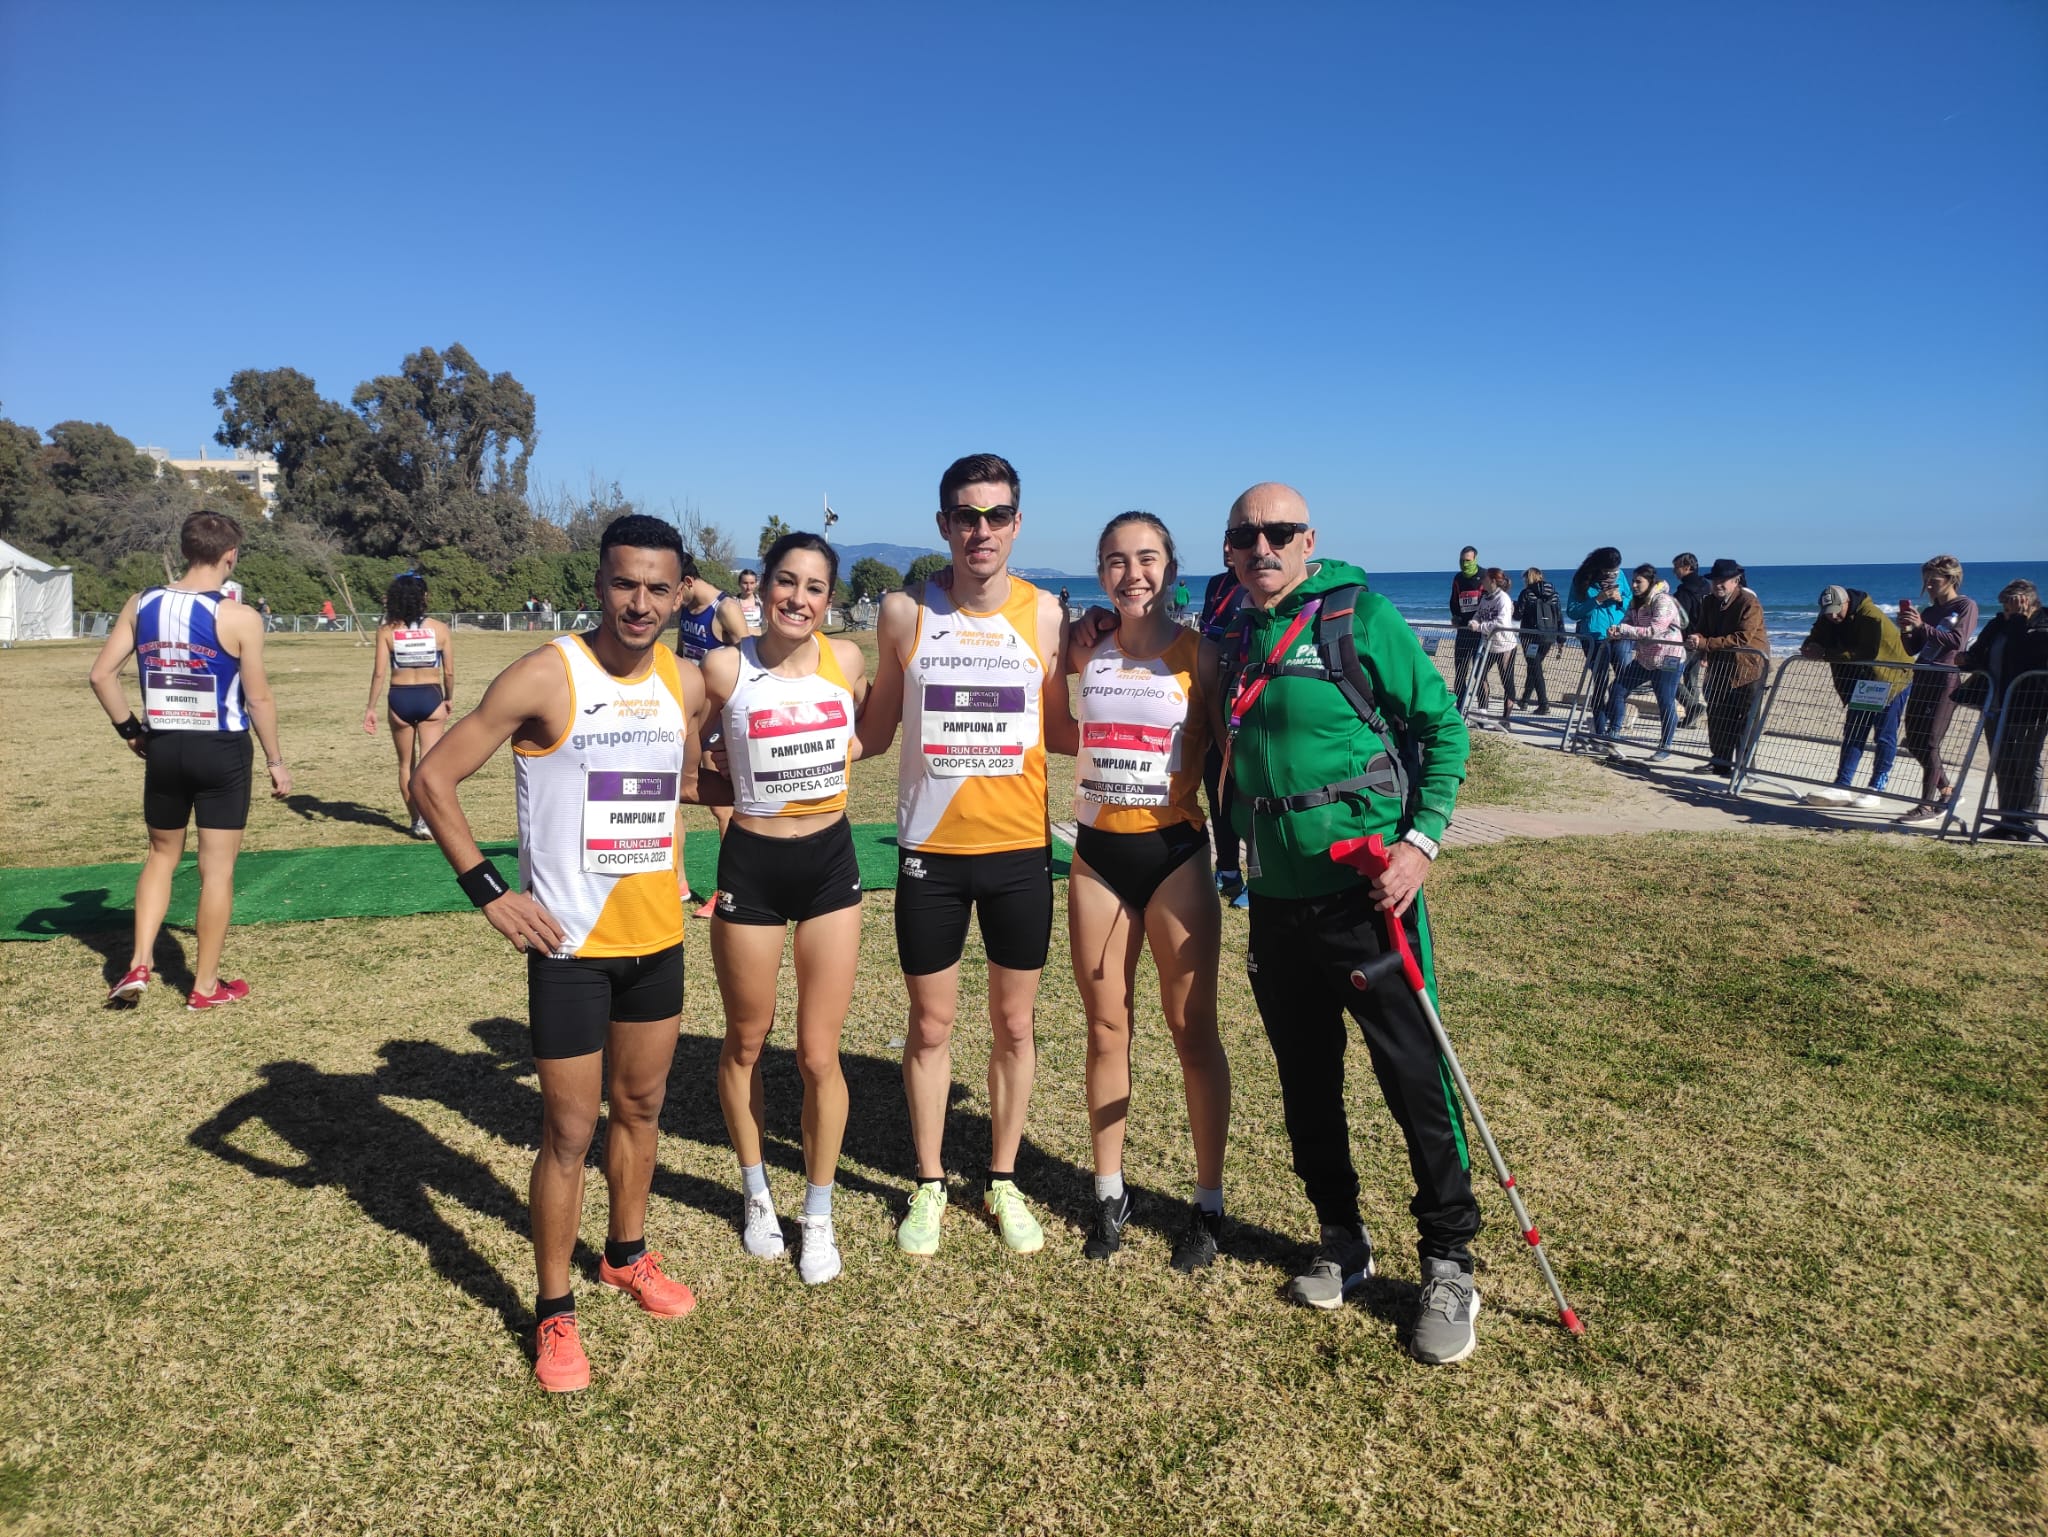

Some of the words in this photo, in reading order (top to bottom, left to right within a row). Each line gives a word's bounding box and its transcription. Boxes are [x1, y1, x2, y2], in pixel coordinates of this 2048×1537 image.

[955, 630, 1004, 640] PAMPLONA
[1295, 644, 1318, 658] PA
[919, 655, 1020, 670] grupompleo
[1082, 686, 1165, 699] grupompleo
[165, 695, 199, 704] VERGOTTE
[153, 717, 192, 725] OROPESA
[943, 721, 993, 733] PAMPLONA
[996, 721, 1008, 733] AT
[572, 727, 675, 750] grupompleo
[771, 740, 824, 758] PAMPLONA
[825, 738, 836, 751] AT
[951, 746, 970, 754] RUN
[972, 746, 1000, 754] CLEAN
[933, 757, 986, 768] OROPESA
[988, 758, 1014, 768] 2023
[1140, 761, 1152, 773] AT
[783, 768, 804, 779] RUN
[805, 764, 833, 776] CLEAN
[765, 779, 822, 794] OROPESA
[1115, 784, 1145, 793] CLEAN
[610, 811, 657, 824] PAMPLONA
[657, 811, 666, 823] AT
[619, 840, 638, 849] RUN
[639, 838, 660, 848] CLEAN
[597, 852, 650, 865] OROPESA
[650, 851, 666, 863] 2023
